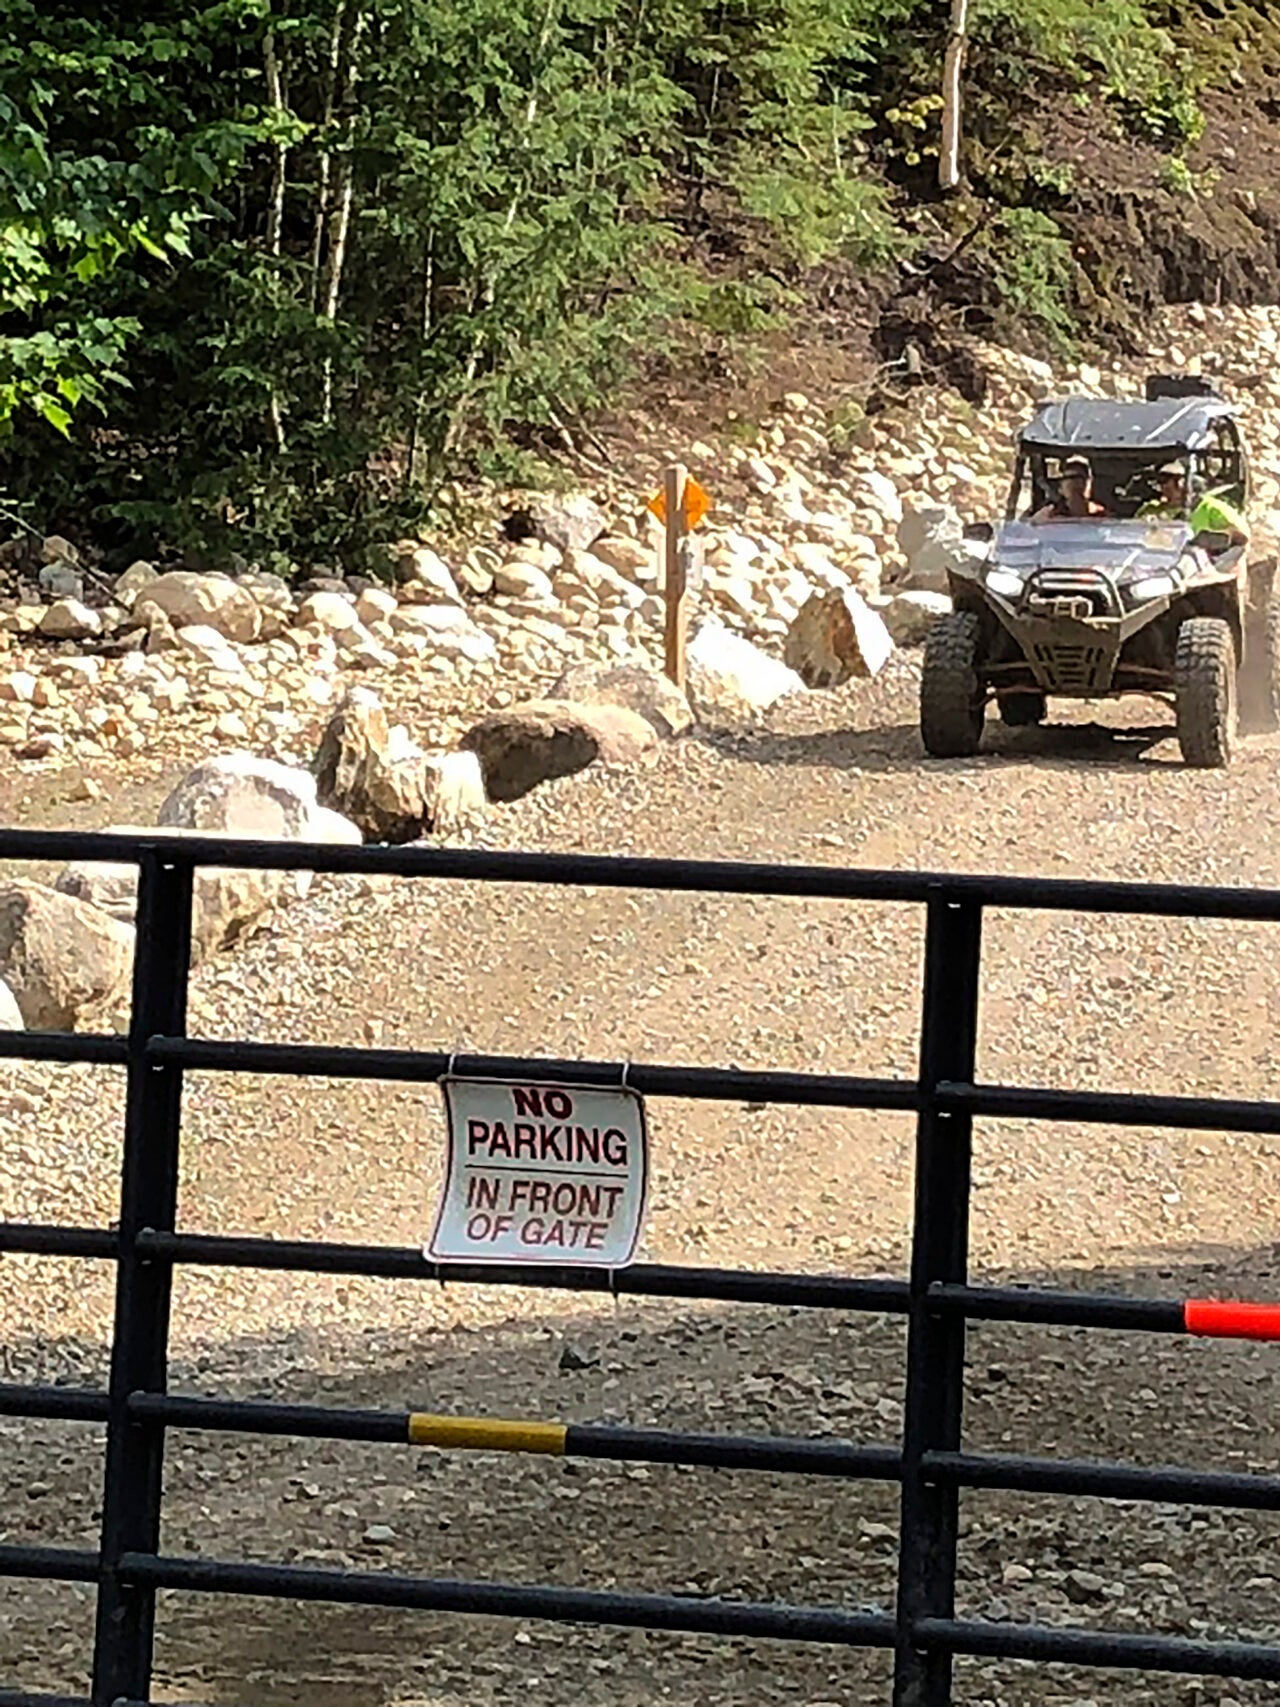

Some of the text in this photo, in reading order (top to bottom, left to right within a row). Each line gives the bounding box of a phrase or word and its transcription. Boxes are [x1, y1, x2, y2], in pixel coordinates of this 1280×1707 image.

[512, 1088, 573, 1120] NO
[468, 1119, 628, 1166] PARKING
[465, 1176, 624, 1219] IN FRONT
[466, 1213, 608, 1250] OF GATE
